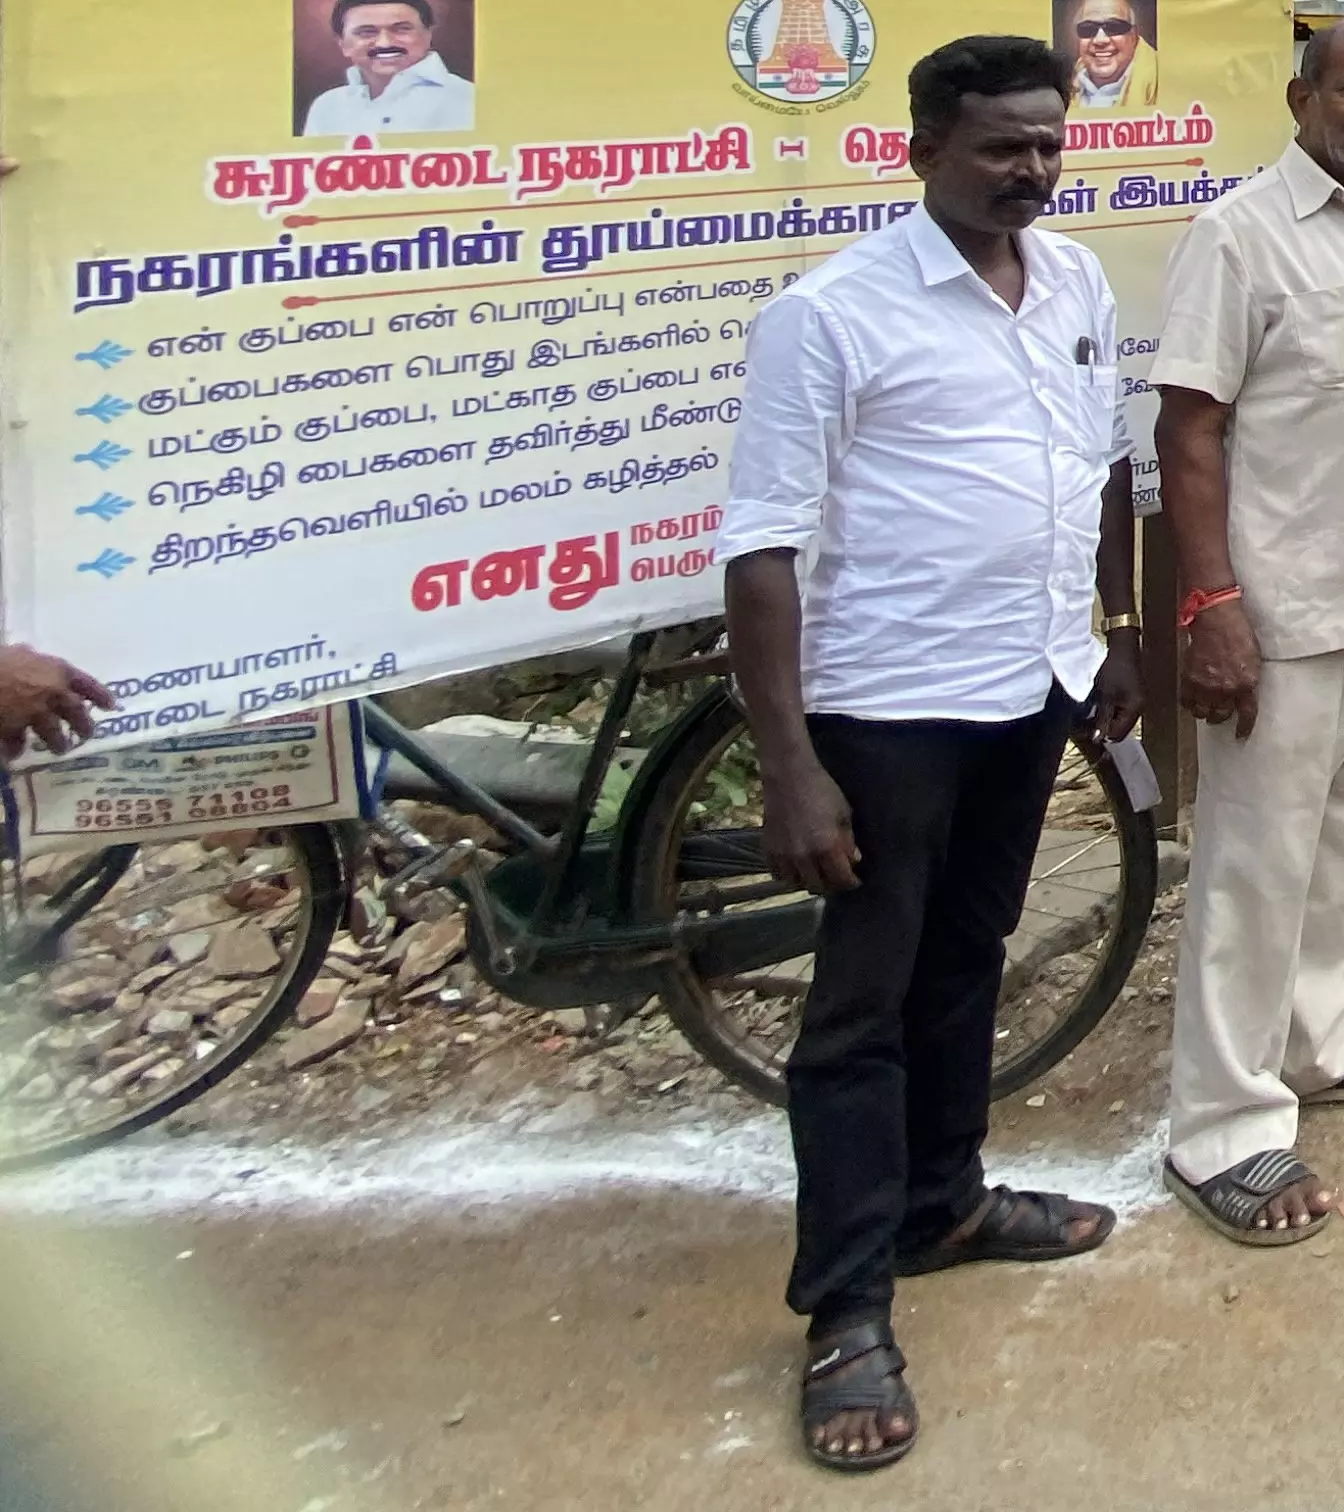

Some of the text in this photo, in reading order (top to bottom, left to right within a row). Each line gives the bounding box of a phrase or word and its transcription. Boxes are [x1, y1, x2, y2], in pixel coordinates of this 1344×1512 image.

[213, 135, 508, 214] சுரண்டை
[515, 127, 749, 201] நகராட்சி
[74, 219, 524, 314] நகரங்களின்
[1110, 164, 1264, 211] இயக்
[147, 325, 227, 359] என்
[239, 316, 374, 352] குப்பை
[389, 303, 458, 333] என்
[470, 287, 625, 325] பொறுப்பு
[635, 276, 773, 305] என்பதை
[138, 319, 710, 415] குப்பைகளை பொது இடங்களில்
[149, 414, 283, 458] மட்கும்
[294, 404, 437, 442] குப்பை,
[452, 383, 577, 417] மட்காத
[587, 367, 699, 401] குப்பை
[148, 397, 743, 512] நெகிழி பைகளை தவிர்த்து மீண்டு
[148, 446, 719, 575] திறந்தவெளியில் மலம் கழித்தல்
[411, 504, 724, 612] எனது நகரம்
[106, 634, 337, 700] ணையாளர்,
[239, 652, 398, 718] நகராட்சி
